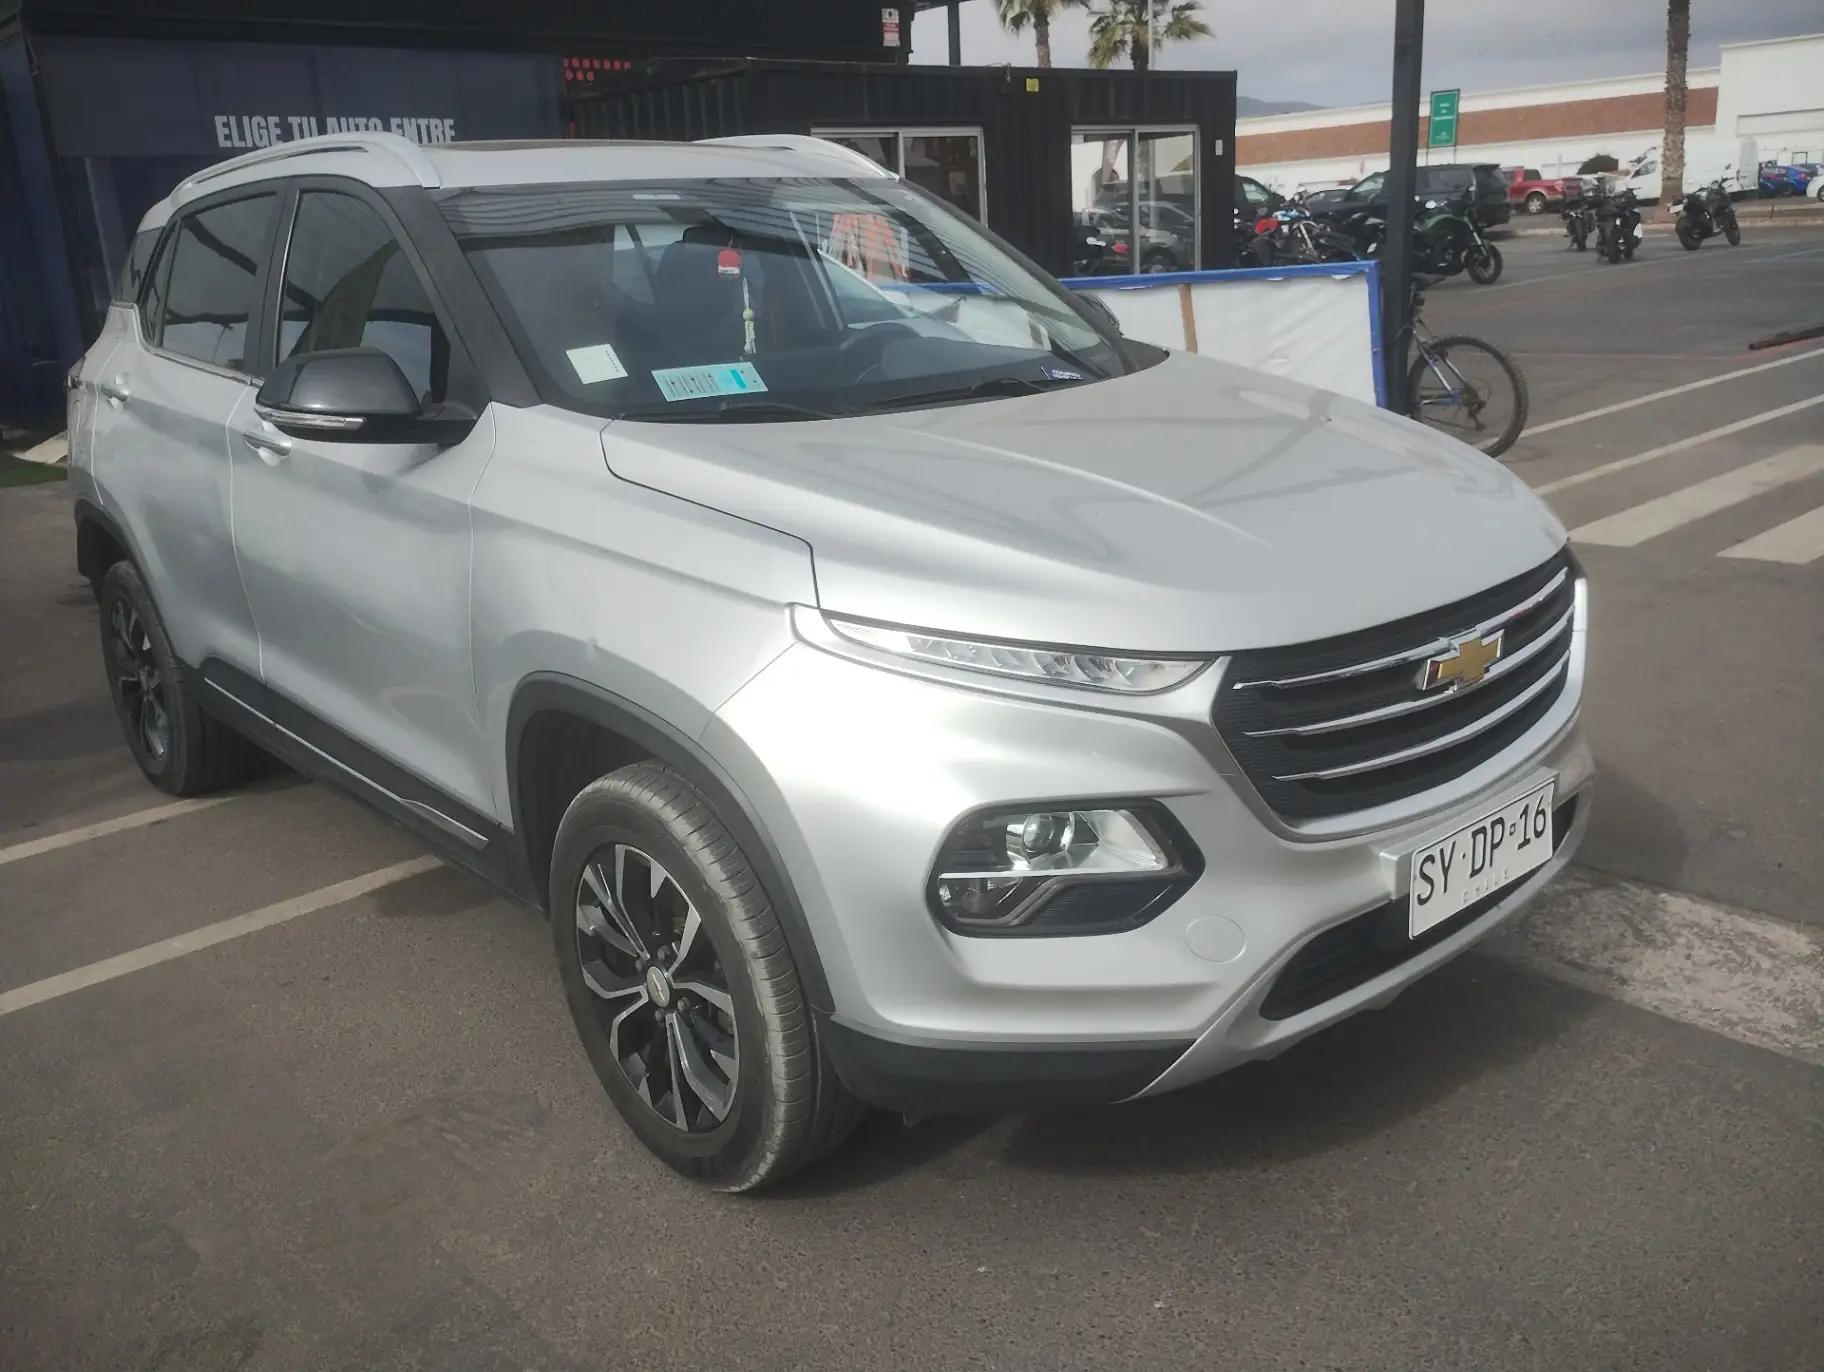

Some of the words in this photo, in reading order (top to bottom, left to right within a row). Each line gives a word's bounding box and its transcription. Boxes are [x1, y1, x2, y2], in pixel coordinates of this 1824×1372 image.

[214, 115, 283, 148] ELIGE
[288, 116, 319, 139] TU
[390, 117, 456, 145] ENTRE
